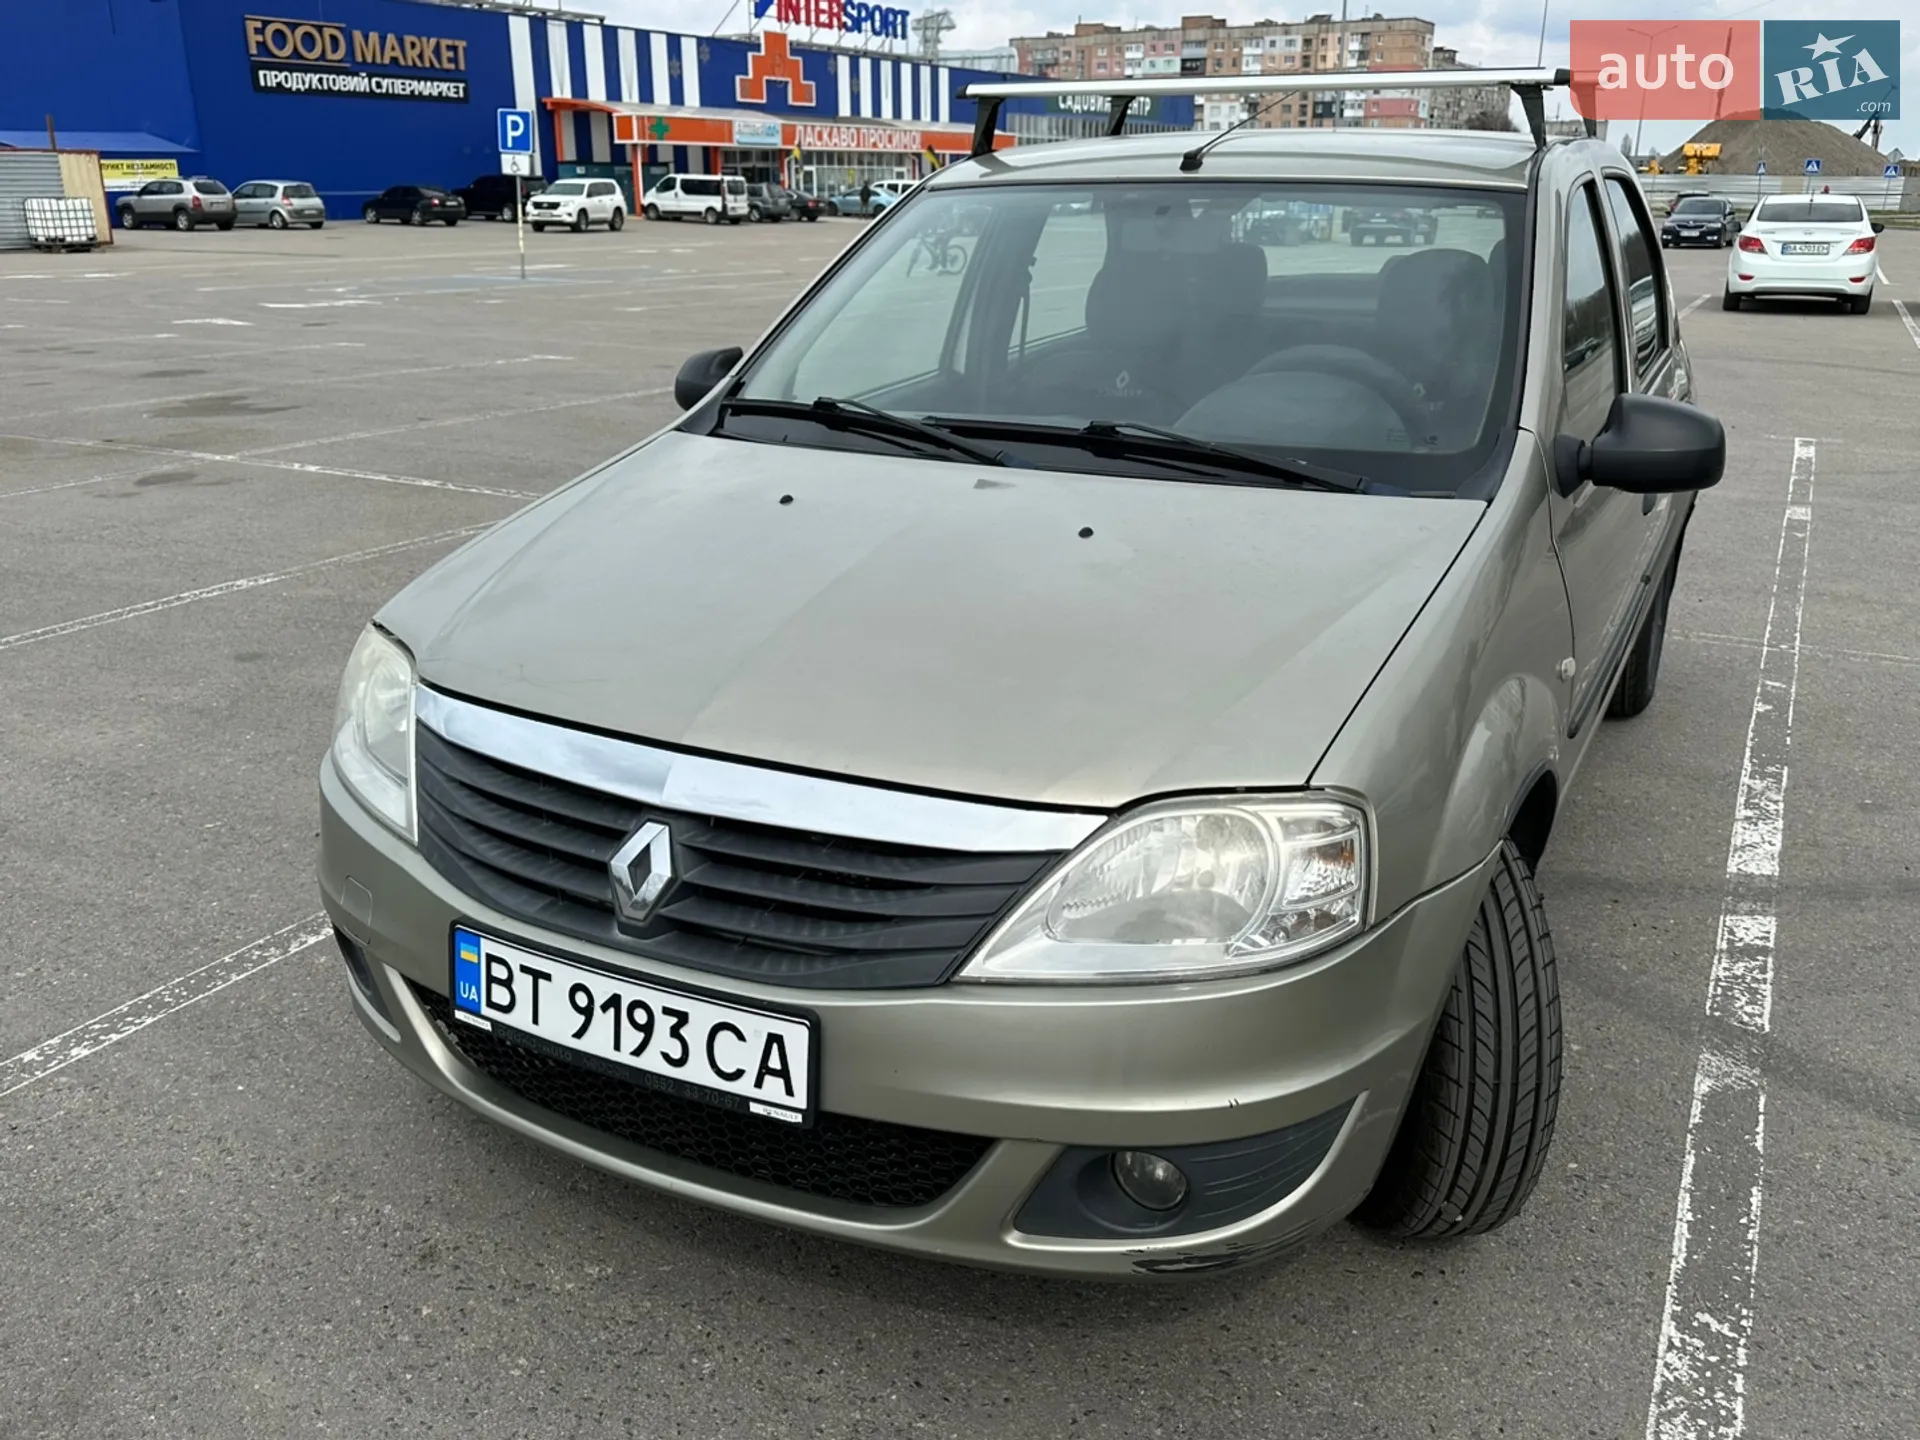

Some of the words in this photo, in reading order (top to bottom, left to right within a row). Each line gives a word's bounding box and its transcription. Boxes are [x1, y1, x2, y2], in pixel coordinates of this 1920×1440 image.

[245, 20, 346, 61] FOOD
[352, 30, 467, 71] MARKET
[258, 69, 370, 93] ПРОДУКТОВИЙ
[371, 77, 466, 98] СУПЕРМАРКЕТ
[506, 114, 525, 148] P
[794, 125, 857, 147] ЛАСКАВО
[859, 127, 922, 149] ПРОСИМО!
[460, 981, 479, 1003] UA
[485, 952, 552, 1026] BT
[568, 982, 690, 1068] 9193
[706, 1021, 795, 1098] CA
